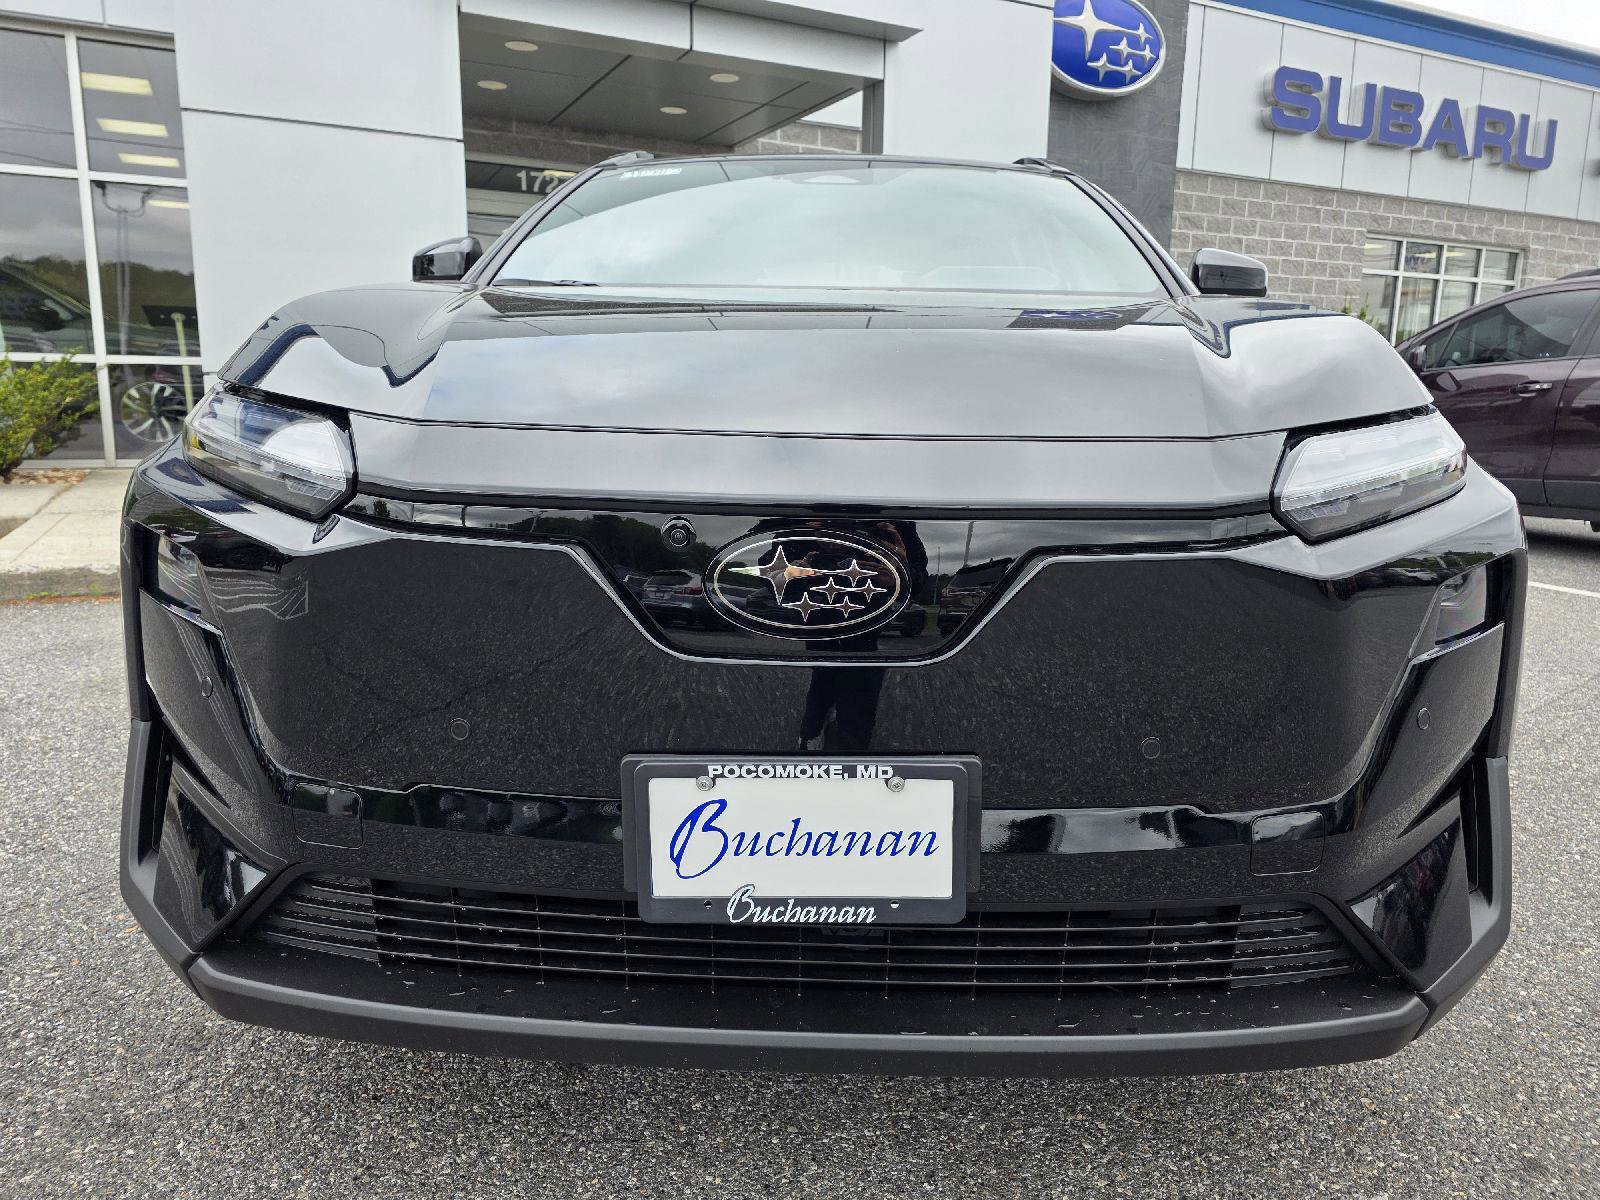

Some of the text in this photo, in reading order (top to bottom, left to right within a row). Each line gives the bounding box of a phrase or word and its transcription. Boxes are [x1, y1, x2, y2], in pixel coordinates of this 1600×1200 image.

[1266, 66, 1559, 171] SUBARU
[516, 170, 570, 193] 172
[708, 765, 894, 780] POCOMOKE, MD
[669, 799, 940, 879] Buchanan
[727, 885, 877, 923] Buchanan
